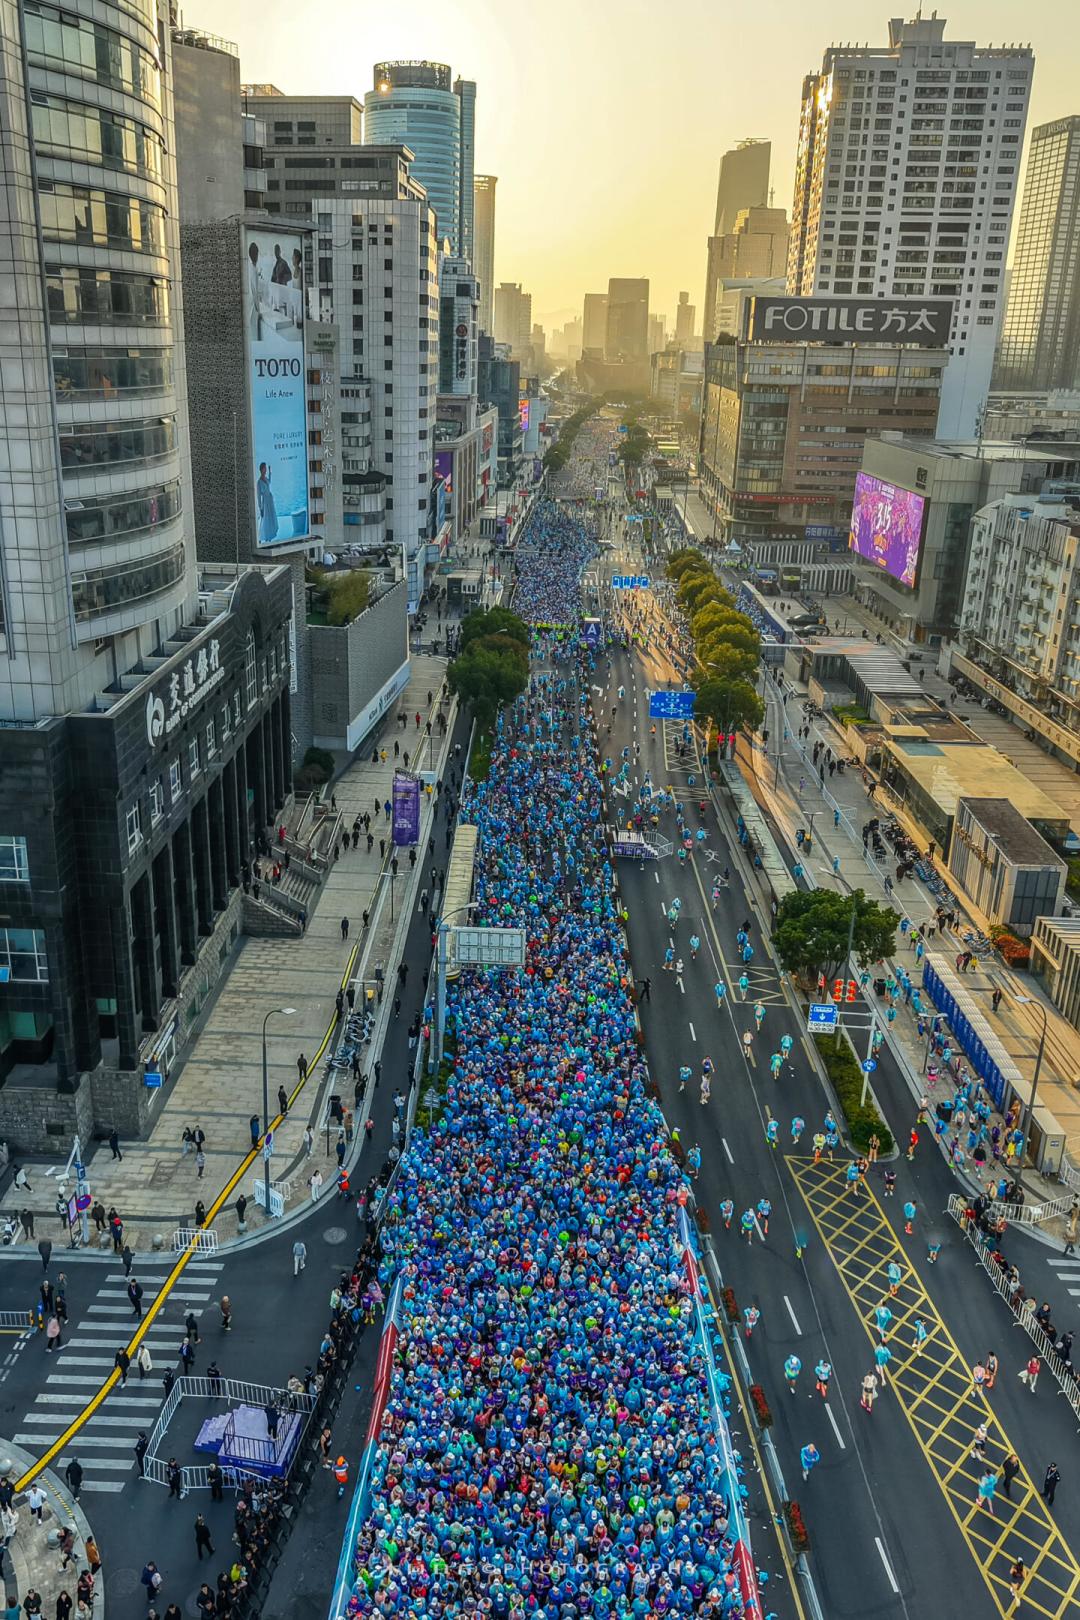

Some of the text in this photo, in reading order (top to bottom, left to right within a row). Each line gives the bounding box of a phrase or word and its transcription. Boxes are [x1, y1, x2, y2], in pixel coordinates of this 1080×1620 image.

[764, 305, 939, 333] FOTILE 方太
[254, 358, 301, 378] TOTO
[265, 389, 277, 398] Life
[587, 622, 597, 636] A
